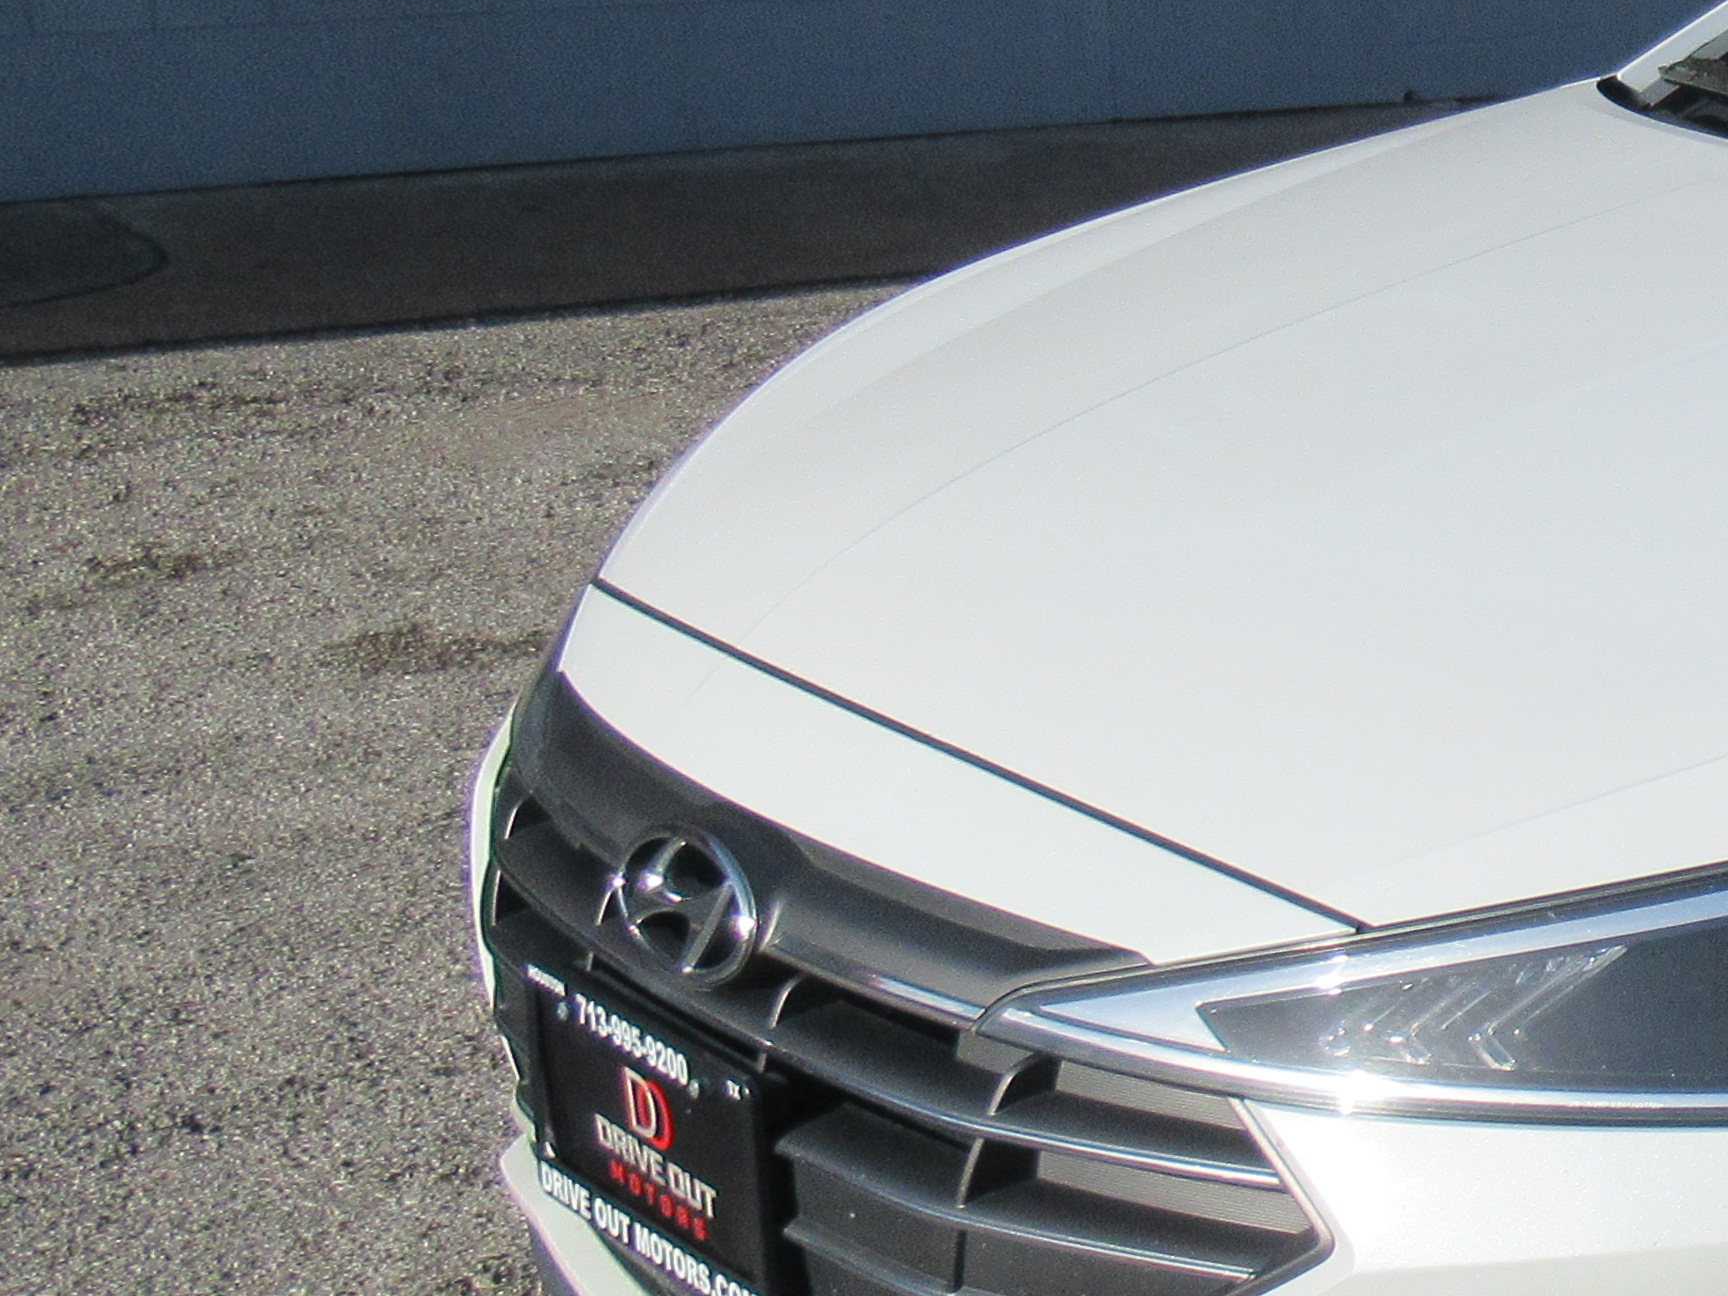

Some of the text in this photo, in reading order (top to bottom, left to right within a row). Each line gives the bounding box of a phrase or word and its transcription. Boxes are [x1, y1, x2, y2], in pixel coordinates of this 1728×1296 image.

[575, 993, 690, 1086] 713-995-9200
[540, 1161, 592, 1221] DRIVE
[594, 1198, 631, 1245] OUT
[595, 1113, 718, 1219] DRIVE OUT
